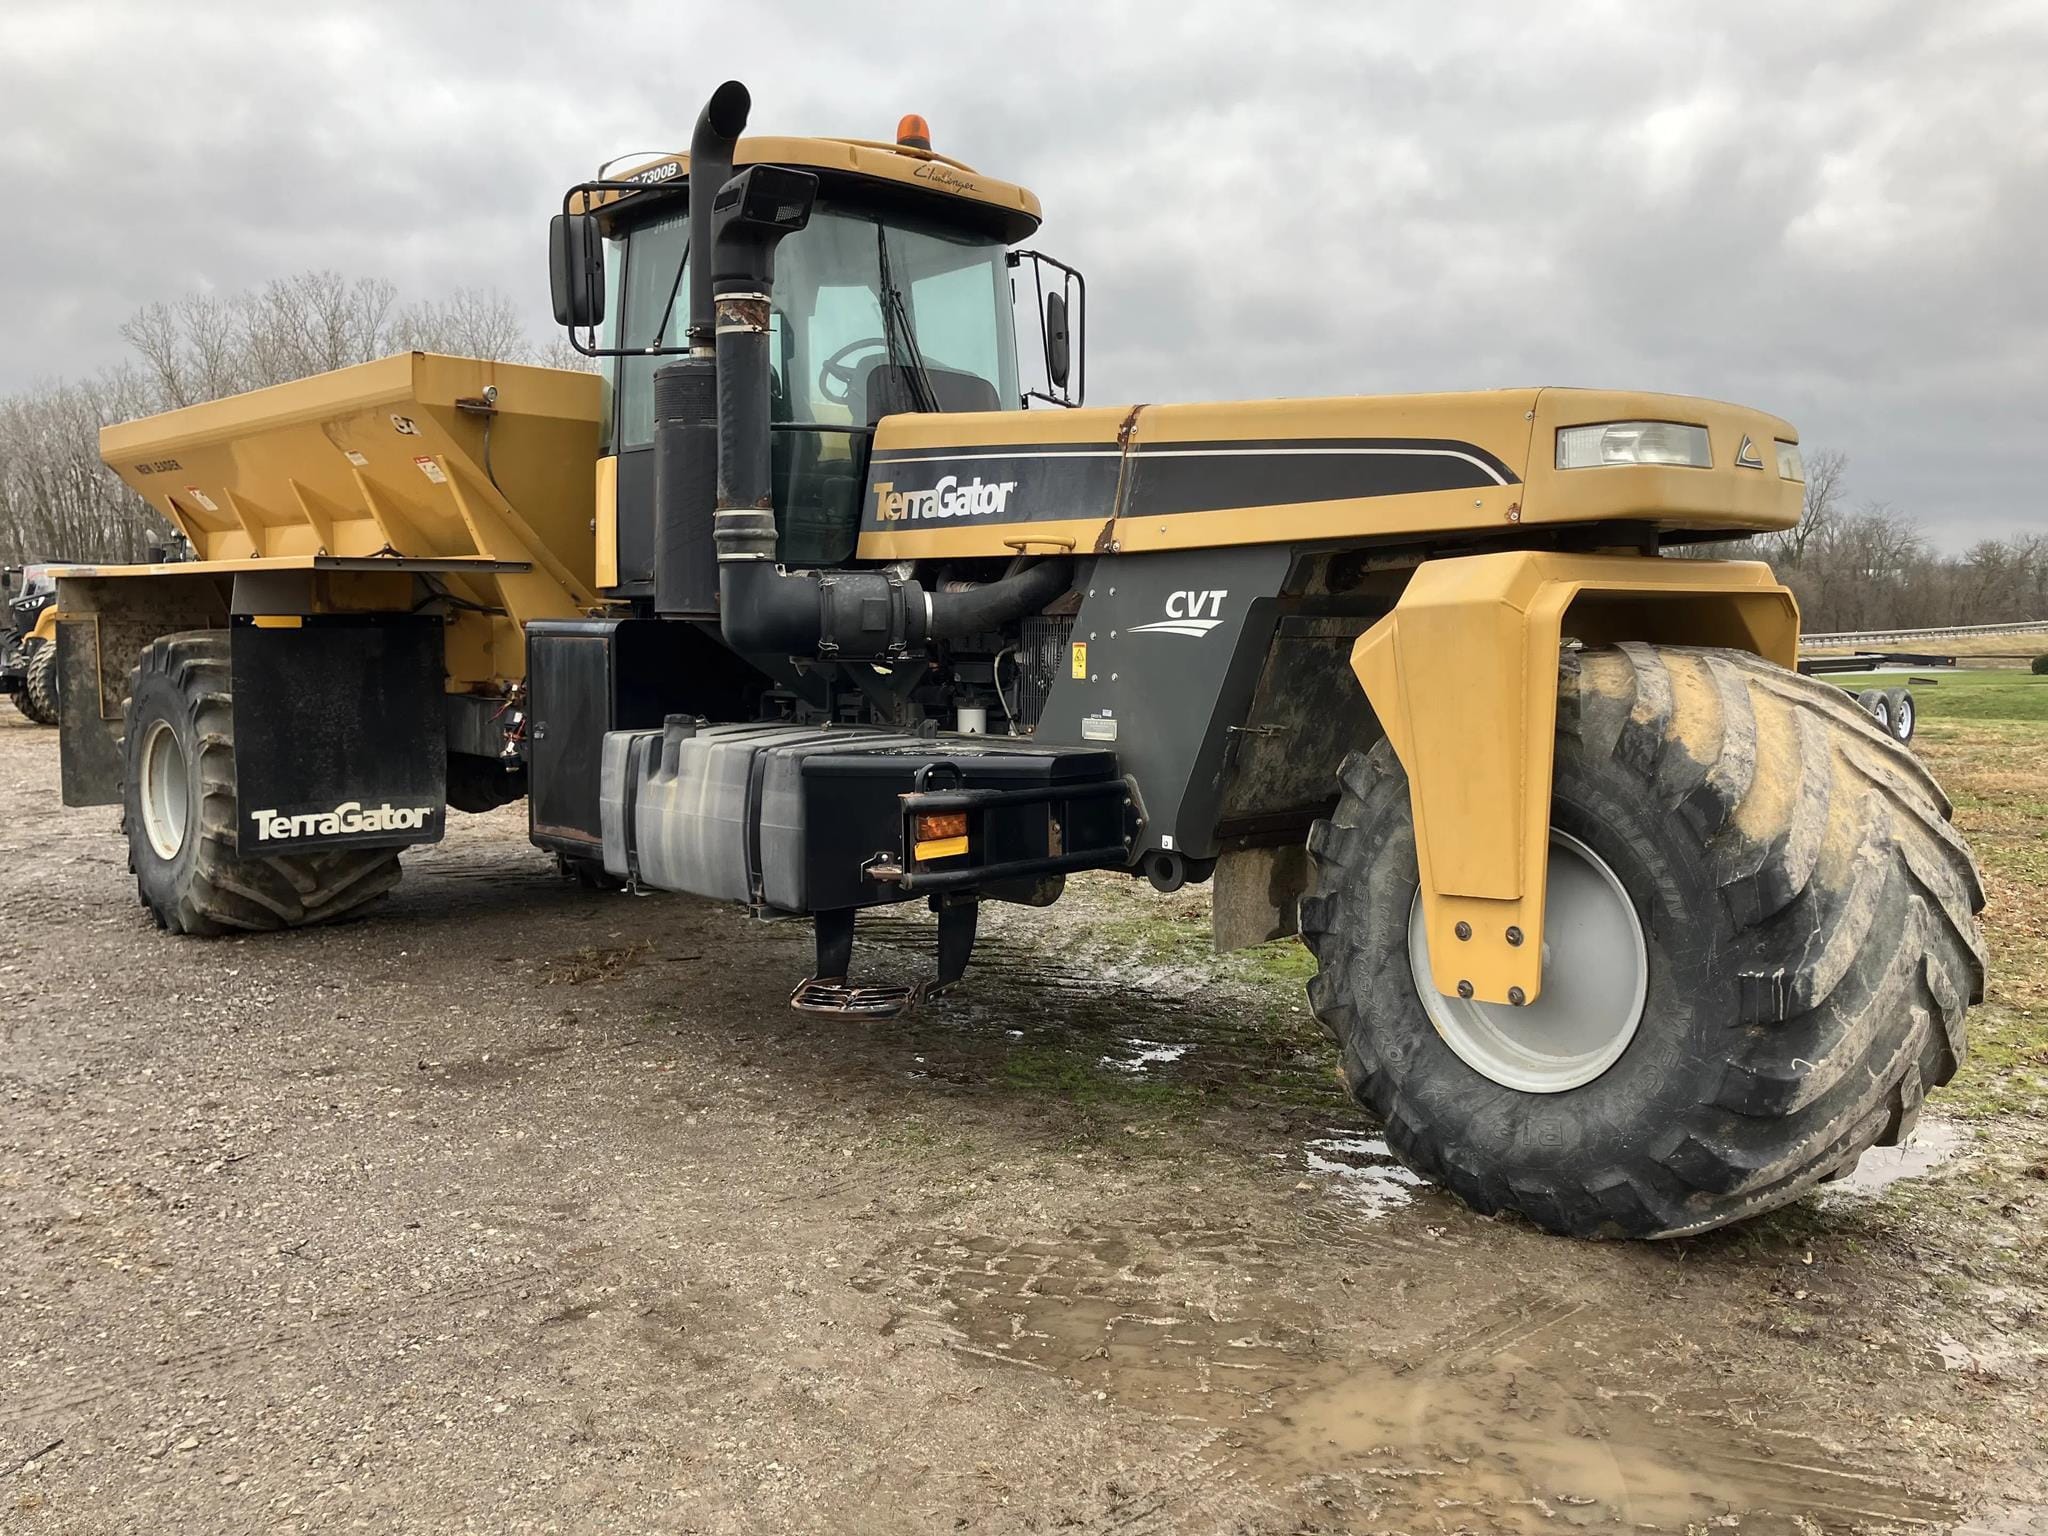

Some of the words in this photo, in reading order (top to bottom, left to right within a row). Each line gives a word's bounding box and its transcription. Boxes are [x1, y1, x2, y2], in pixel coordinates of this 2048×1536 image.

[641, 162, 678, 184] 7300B
[873, 475, 1016, 522] TerraGator
[1165, 589, 1228, 619] CVT
[251, 801, 431, 841] TerraGator
